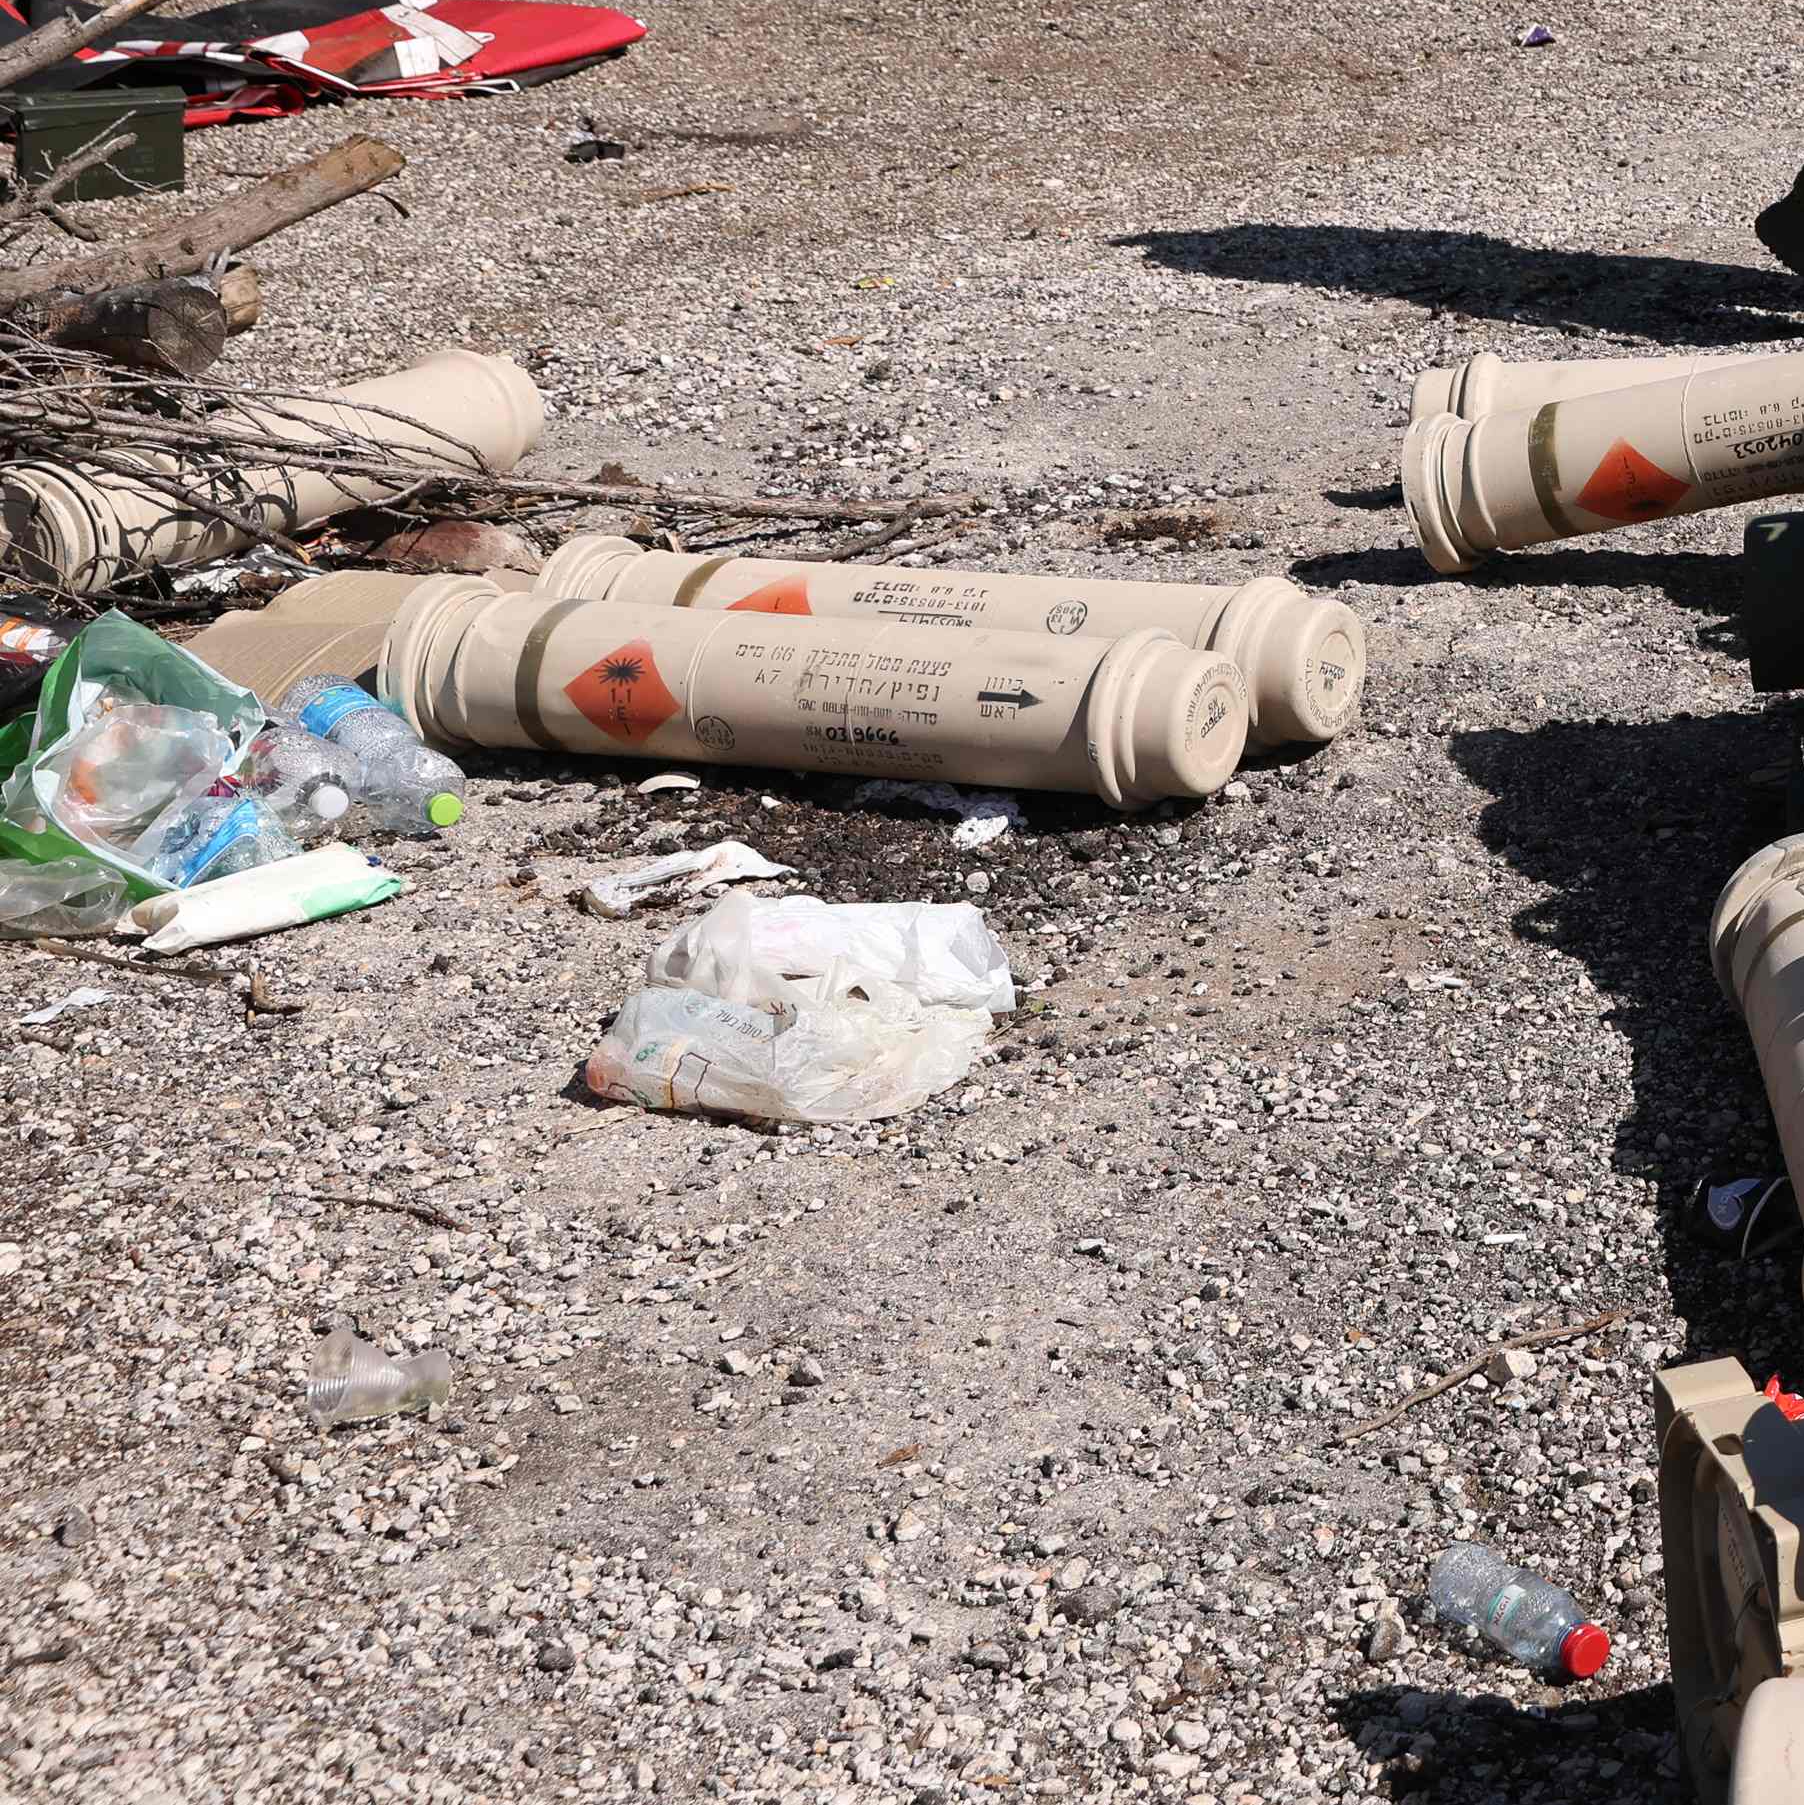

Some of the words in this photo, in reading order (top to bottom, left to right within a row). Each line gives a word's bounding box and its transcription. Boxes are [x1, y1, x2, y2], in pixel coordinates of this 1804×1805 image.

[1733, 432, 1803, 459] 042033
[805, 647, 861, 669] מתכלה
[867, 653, 904, 673] מטול
[906, 658, 952, 677] פצצת
[980, 703, 1018, 720] ראש
[825, 725, 899, 746] 039666
